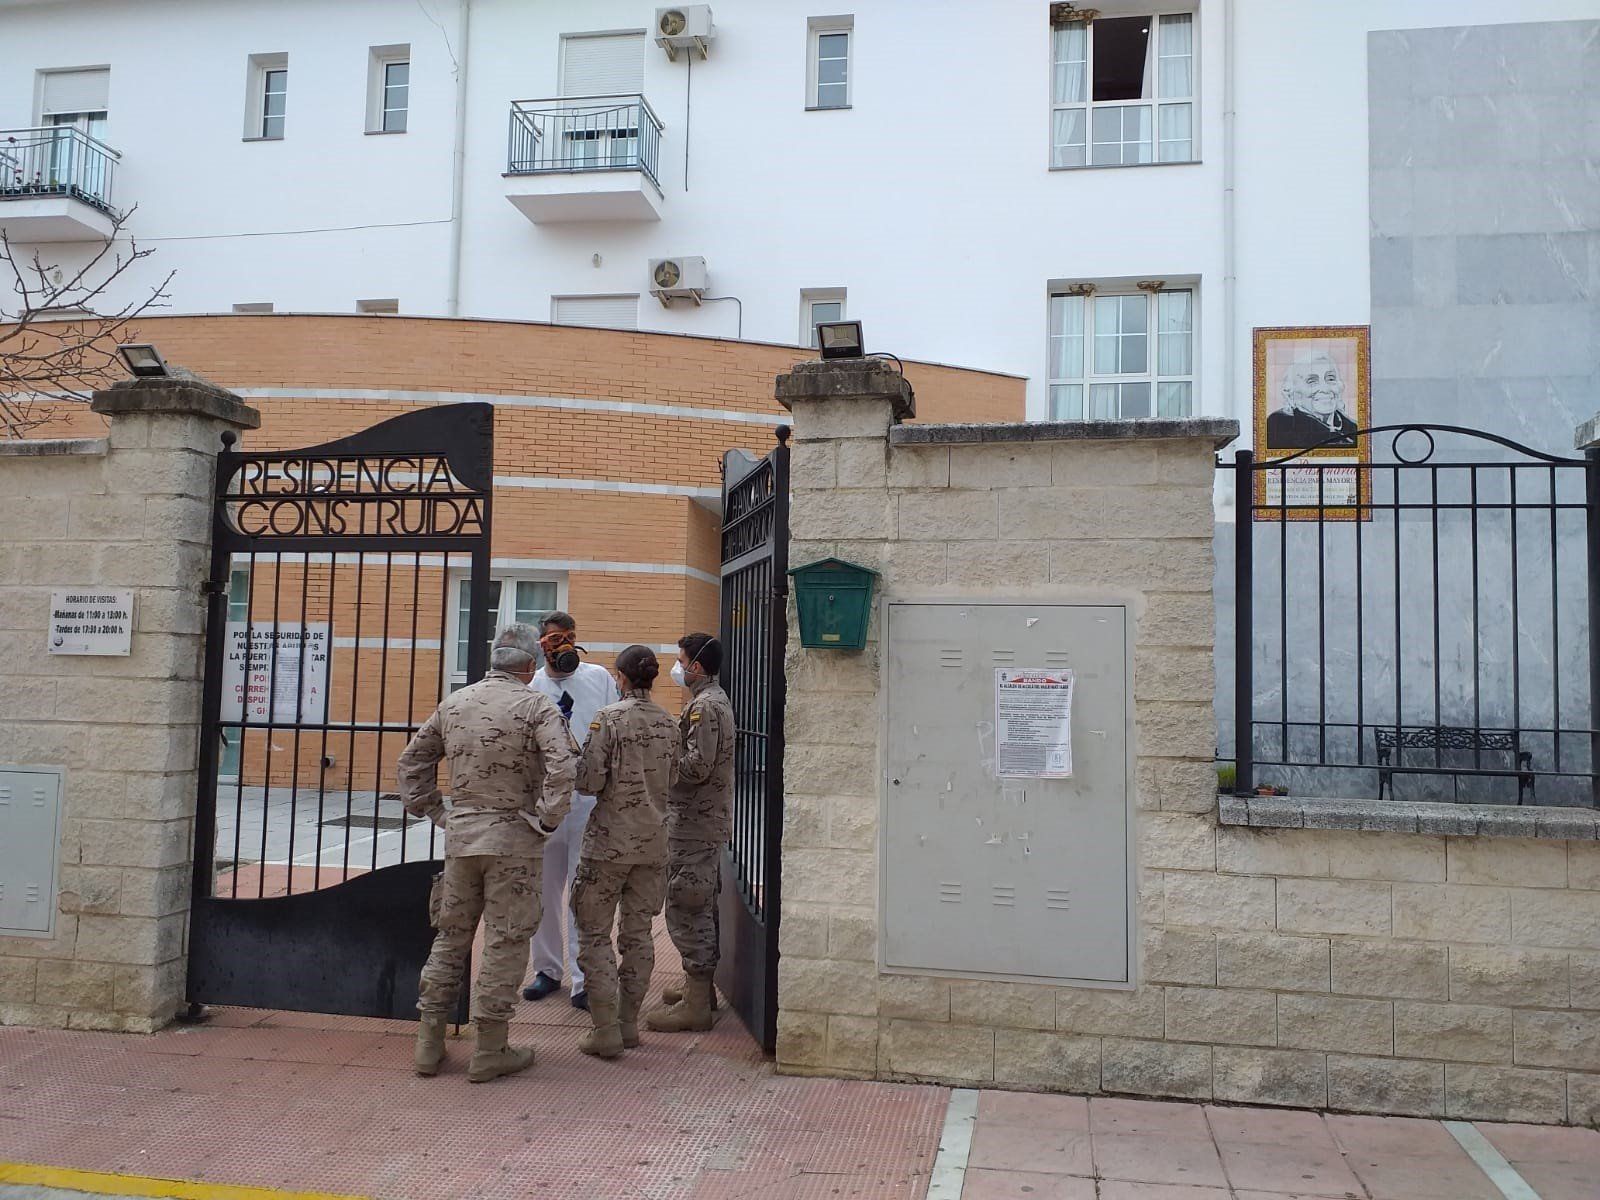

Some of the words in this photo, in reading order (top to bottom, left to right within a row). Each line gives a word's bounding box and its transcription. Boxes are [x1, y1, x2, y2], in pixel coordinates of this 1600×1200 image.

[240, 457, 456, 495] RESIDENCIA
[238, 499, 484, 536] CONSTRUIDA
[78, 610, 85, 619] de
[252, 631, 262, 639] LA
[313, 632, 324, 640] DE
[229, 652, 240, 660] LA
